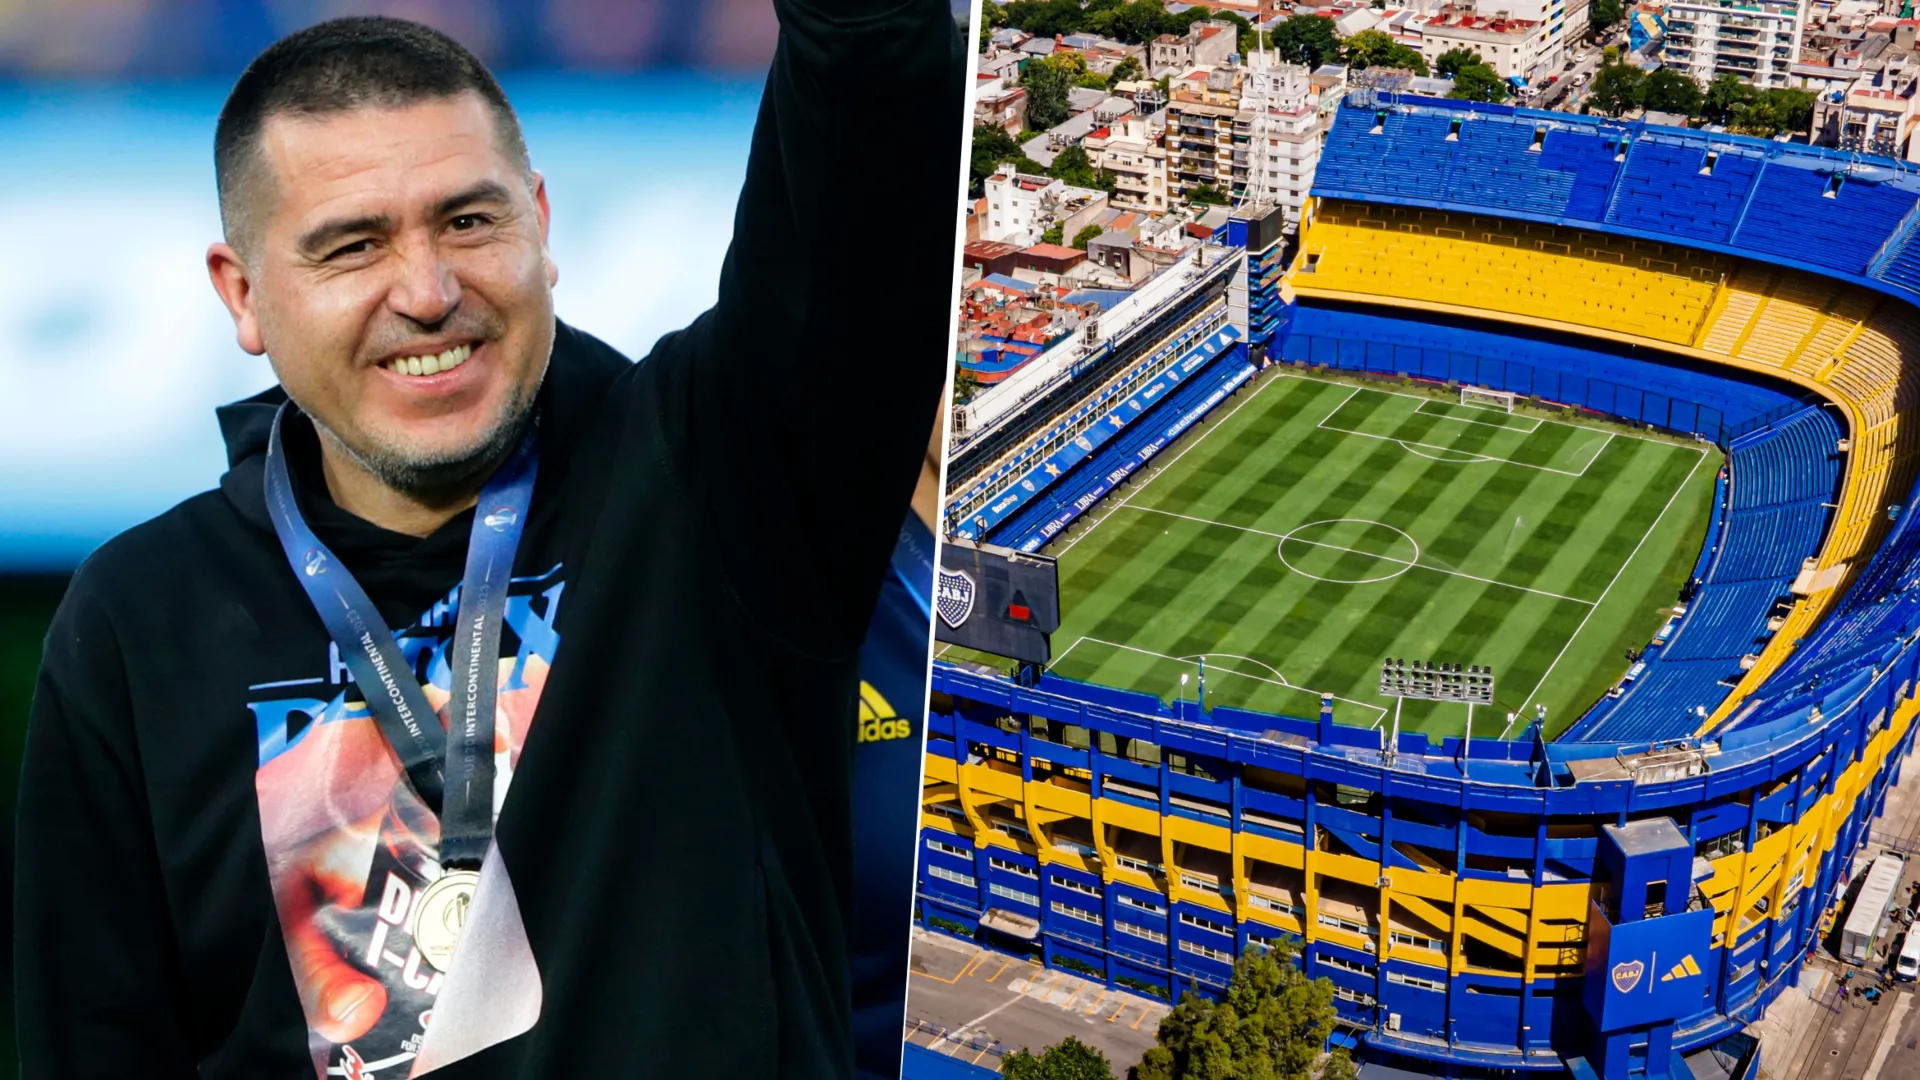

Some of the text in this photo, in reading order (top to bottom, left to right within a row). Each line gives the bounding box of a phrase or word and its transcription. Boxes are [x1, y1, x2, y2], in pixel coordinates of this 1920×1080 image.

[1138, 443, 1159, 460] LIBRA
[1106, 467, 1128, 485] LIBRA
[1074, 493, 1097, 511] LIBRA
[1040, 519, 1064, 538] LIBRA
[360, 631, 423, 738] INTERCONTINENTAL
[465, 614, 485, 738] INTERCONTINENTAL
[1615, 970, 1640, 980] CABJ
